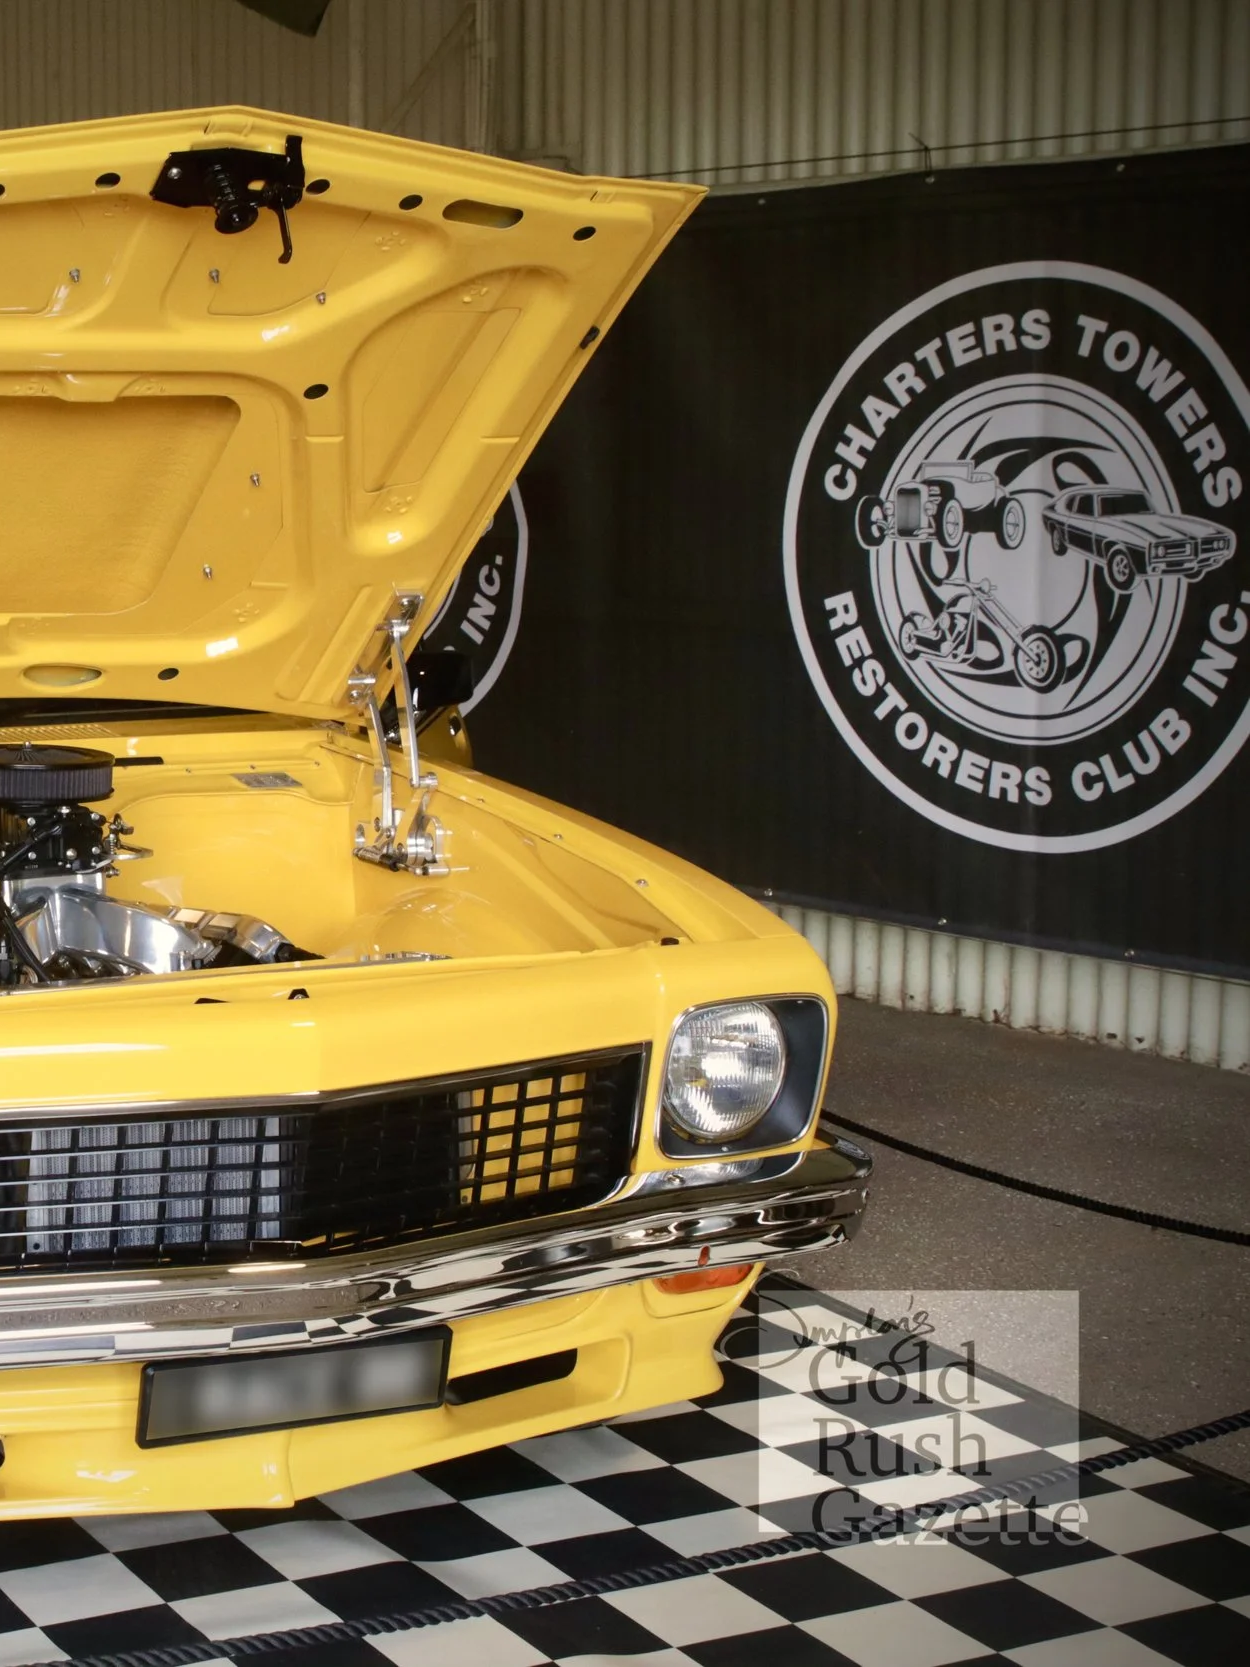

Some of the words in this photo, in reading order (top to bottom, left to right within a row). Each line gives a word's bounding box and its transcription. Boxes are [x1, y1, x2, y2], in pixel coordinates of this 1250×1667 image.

[824, 308, 1051, 502] CHARTERS
[1075, 314, 1243, 508] TOWERS
[460, 555, 503, 645] INC.
[823, 590, 1052, 806] RESTORERS
[1071, 706, 1193, 803] CLUB
